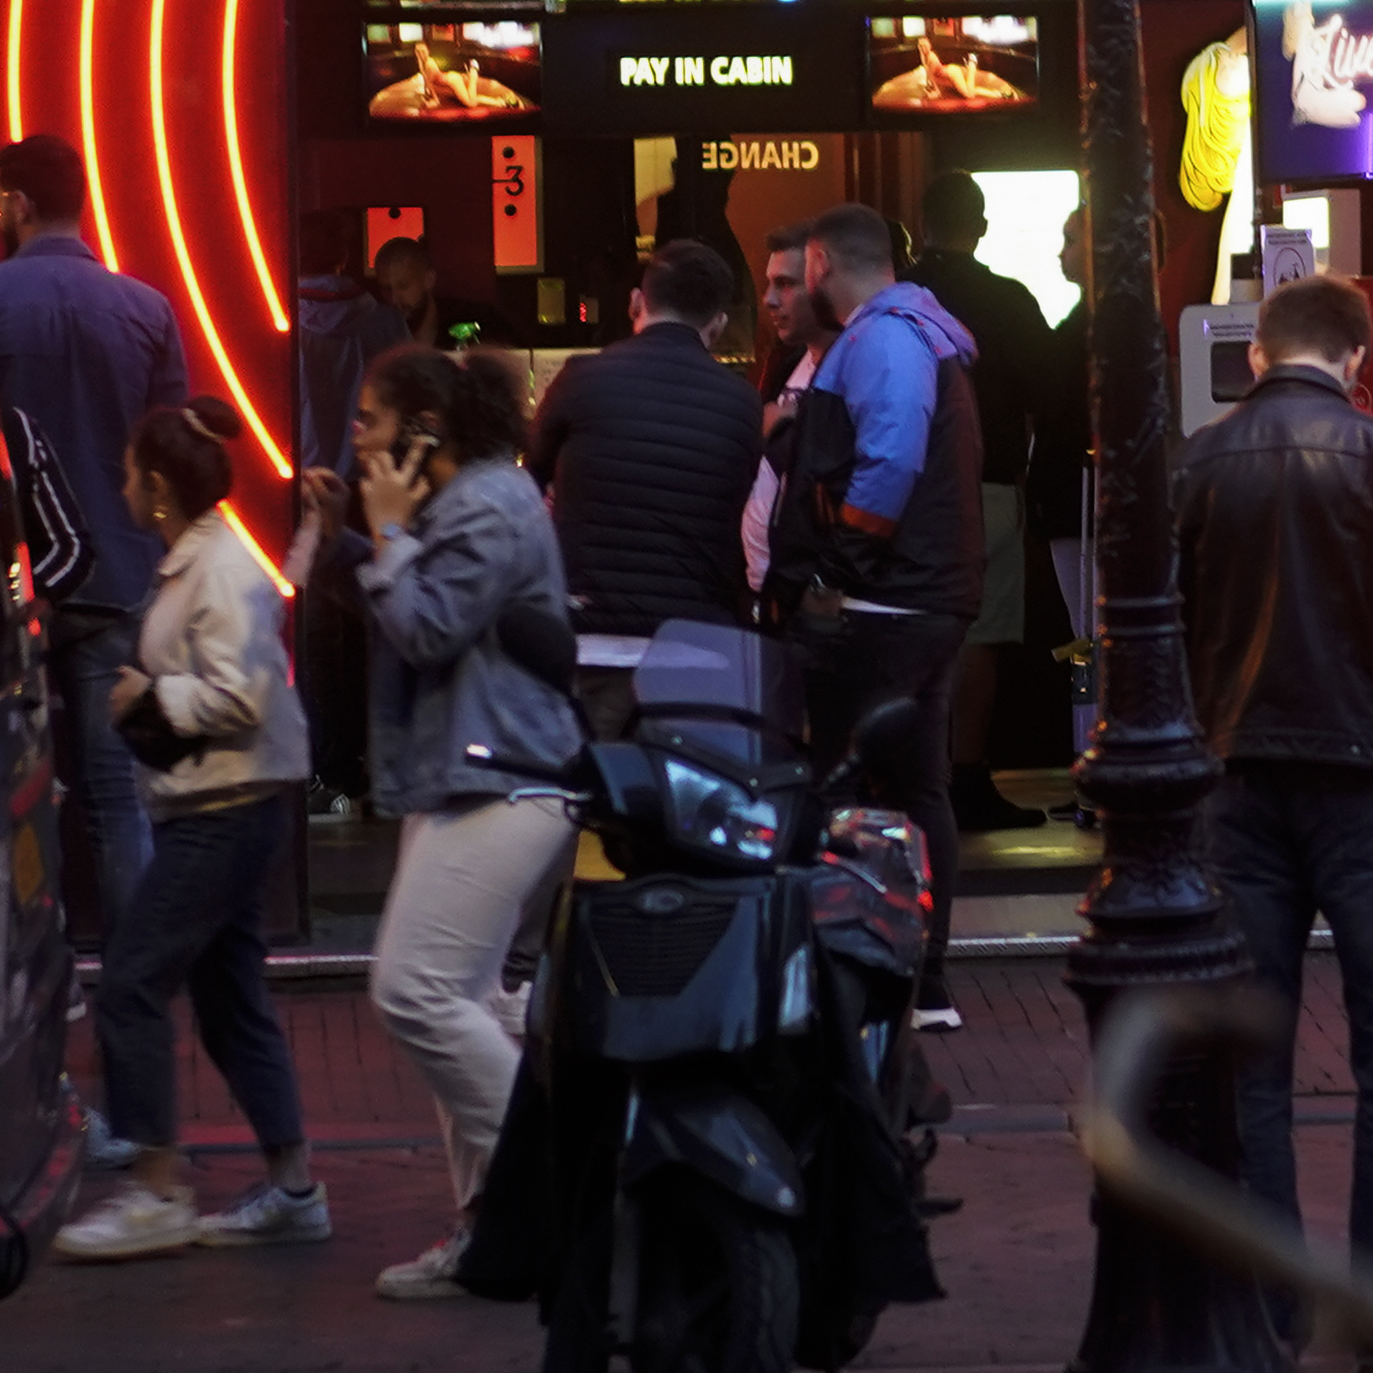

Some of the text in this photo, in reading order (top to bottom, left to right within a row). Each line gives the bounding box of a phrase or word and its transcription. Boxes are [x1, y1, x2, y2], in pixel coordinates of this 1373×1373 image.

[619, 55, 793, 87] PAY IN CABIN
